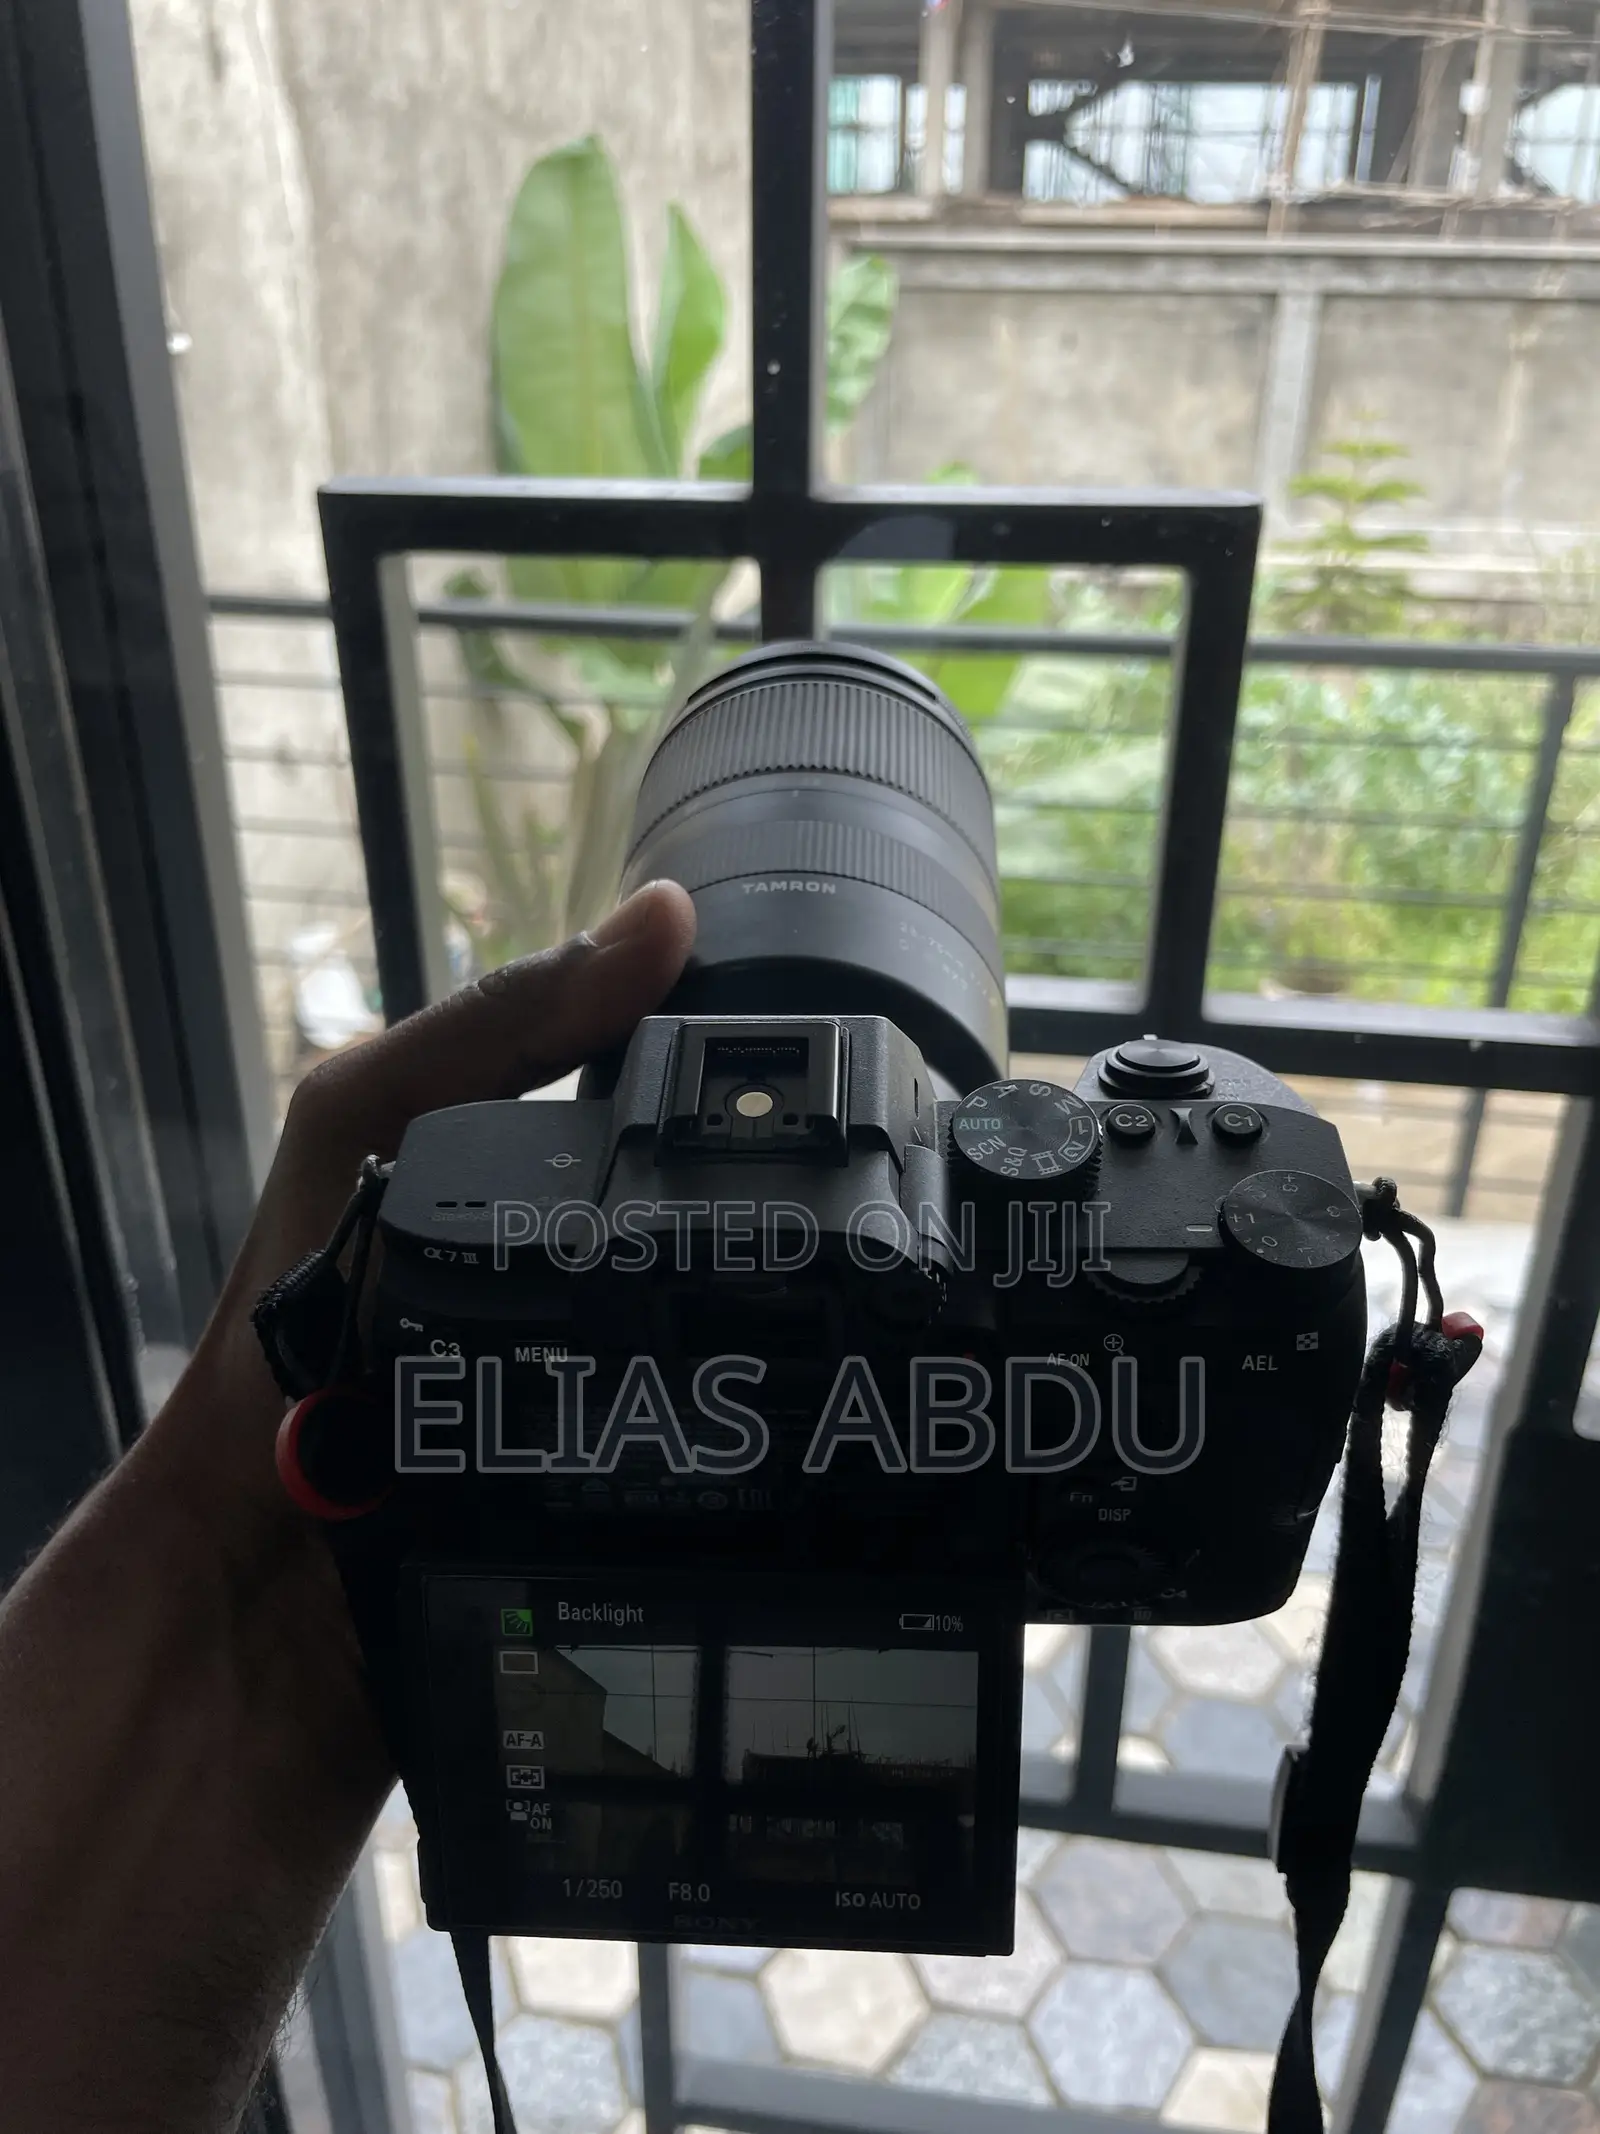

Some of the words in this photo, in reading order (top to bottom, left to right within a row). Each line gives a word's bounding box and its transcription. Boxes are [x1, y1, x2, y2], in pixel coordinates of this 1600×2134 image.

[742, 881, 836, 895] TAMRON
[966, 1096, 988, 1109] P
[958, 1117, 1001, 1130] AUTO
[1115, 1113, 1149, 1127] C2
[1223, 1112, 1255, 1128] C1
[966, 1135, 1007, 1161] SCN
[430, 1338, 461, 1358] C3
[514, 1346, 568, 1363] MENU
[1241, 1355, 1278, 1371] AEL
[1098, 1508, 1131, 1522] DISP
[557, 1601, 645, 1626] Backlight
[935, 1615, 963, 1632] 10%
[506, 1733, 542, 1747] AF-A
[531, 1803, 551, 1816] AF
[530, 1817, 552, 1831] ON
[562, 1878, 623, 1900] 1/250
[668, 1882, 711, 1902] F8.0
[835, 1890, 866, 1908] ISO
[869, 1893, 921, 1911] AUTO
